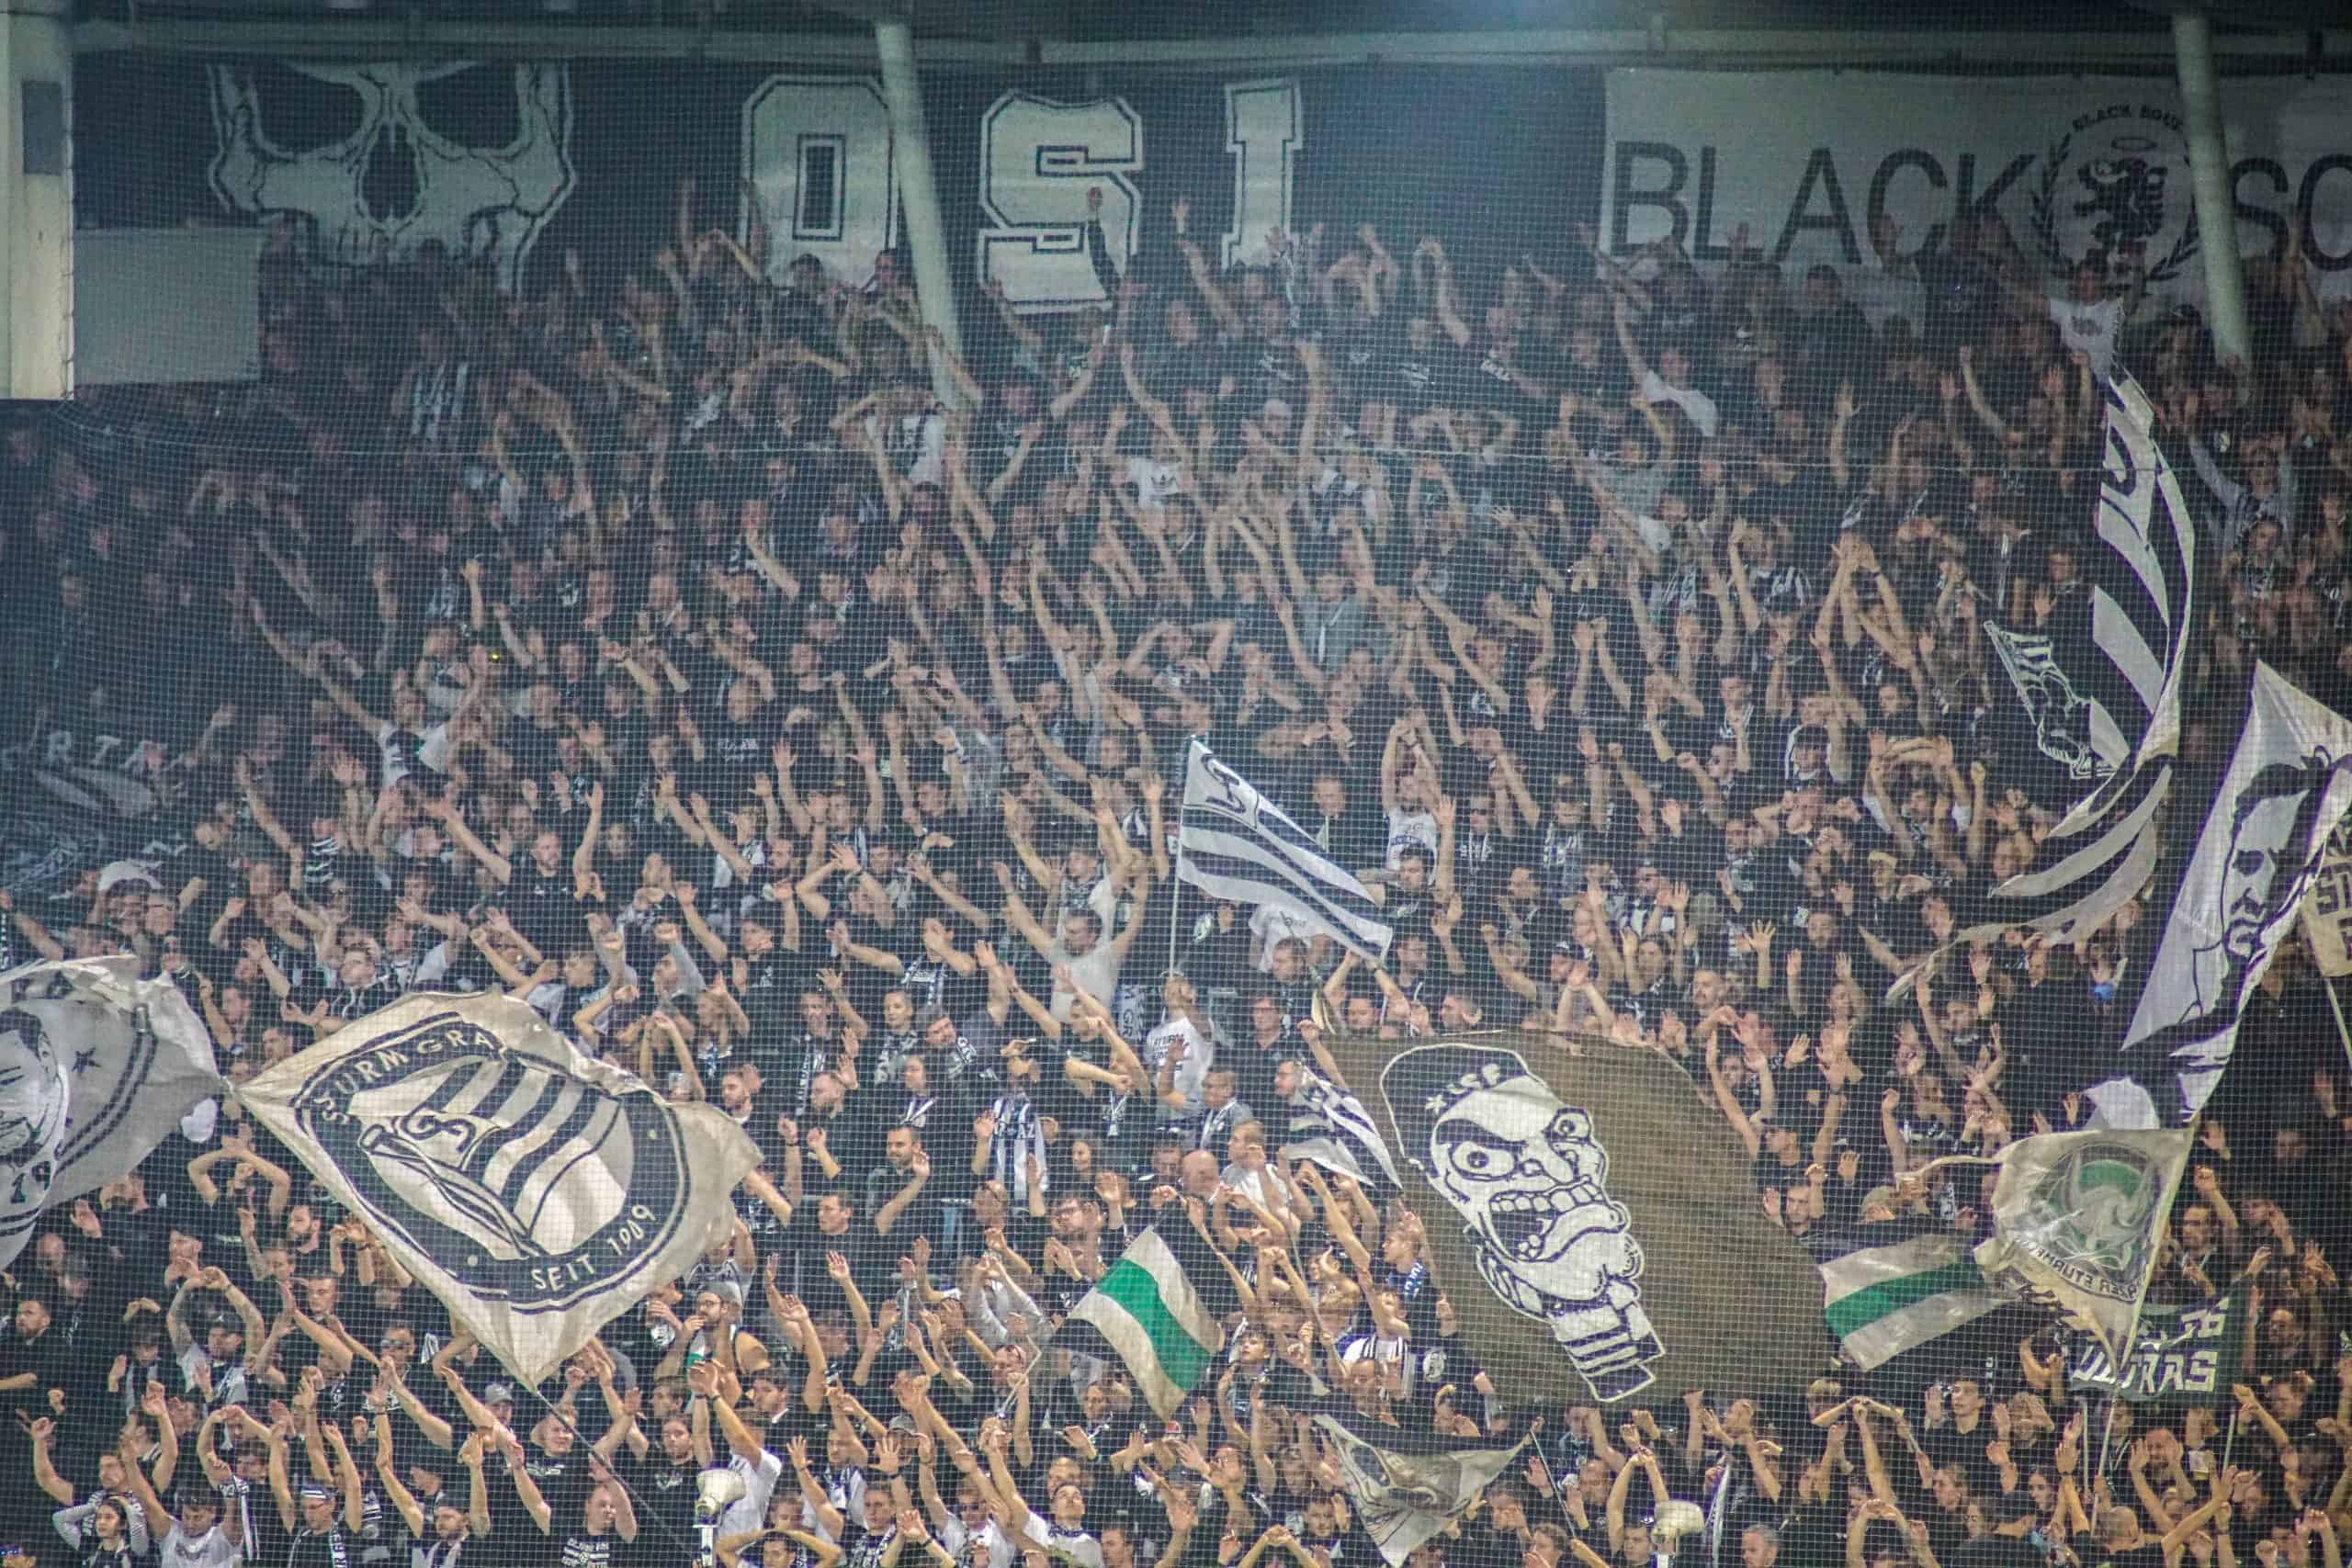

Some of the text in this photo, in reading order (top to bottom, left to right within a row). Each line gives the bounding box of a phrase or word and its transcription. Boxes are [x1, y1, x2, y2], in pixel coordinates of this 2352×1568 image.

[1610, 140, 2037, 266] BLACK
[417, 1029, 495, 1055] GRA
[530, 1254, 596, 1292] SEIT
